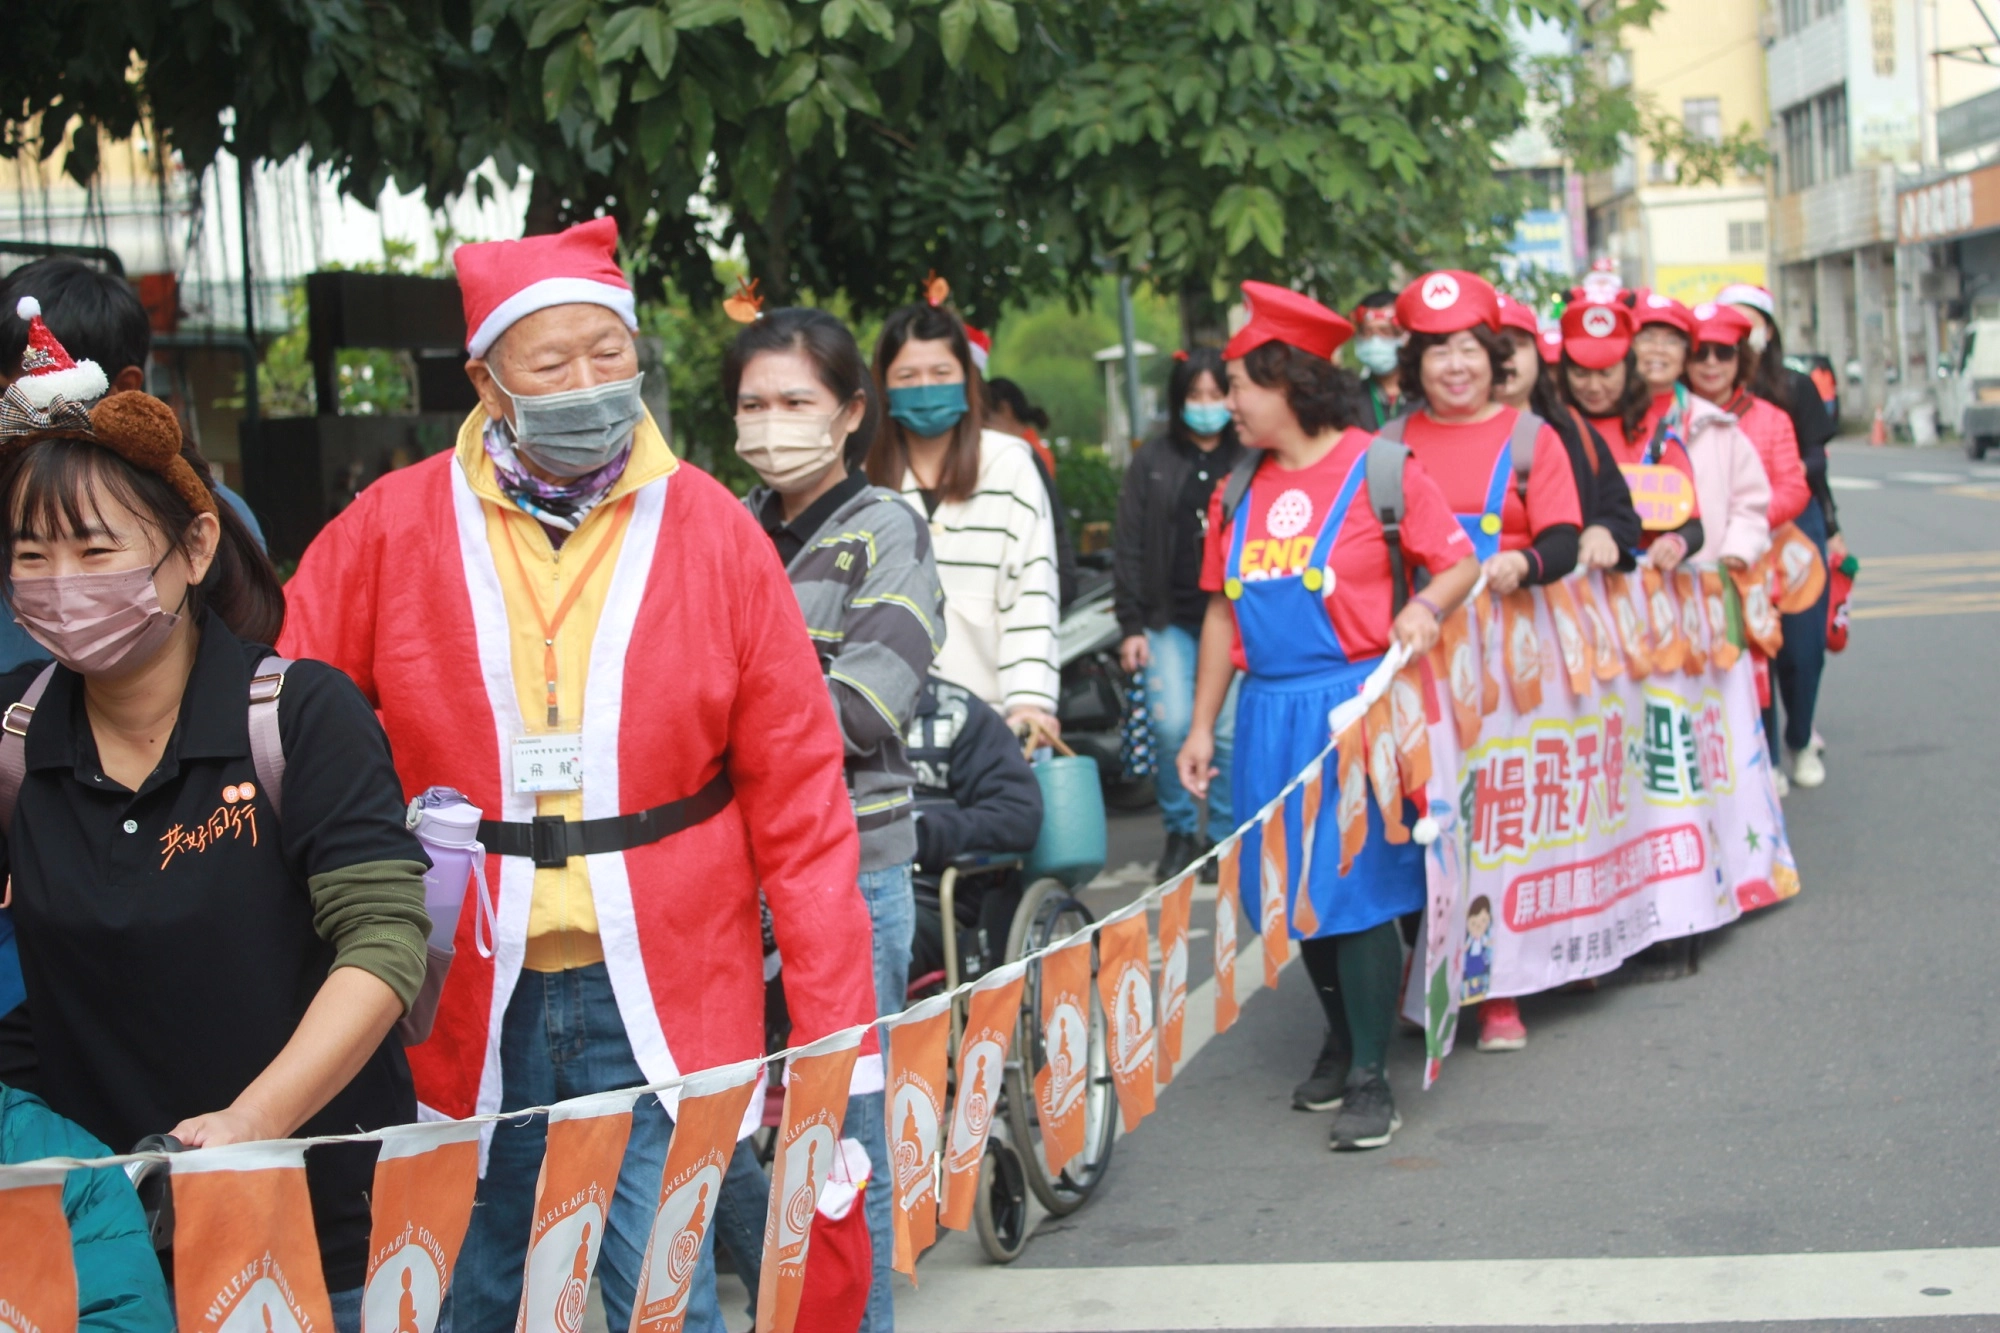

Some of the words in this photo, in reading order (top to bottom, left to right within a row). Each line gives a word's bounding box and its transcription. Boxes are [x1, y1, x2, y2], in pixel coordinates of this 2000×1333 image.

[1240, 536, 1317, 574] END
[159, 803, 258, 871] 共好同行
[664, 1154, 707, 1196] WELFARE
[536, 1187, 586, 1233] WELFARE
[204, 1258, 259, 1324] WELFARE
